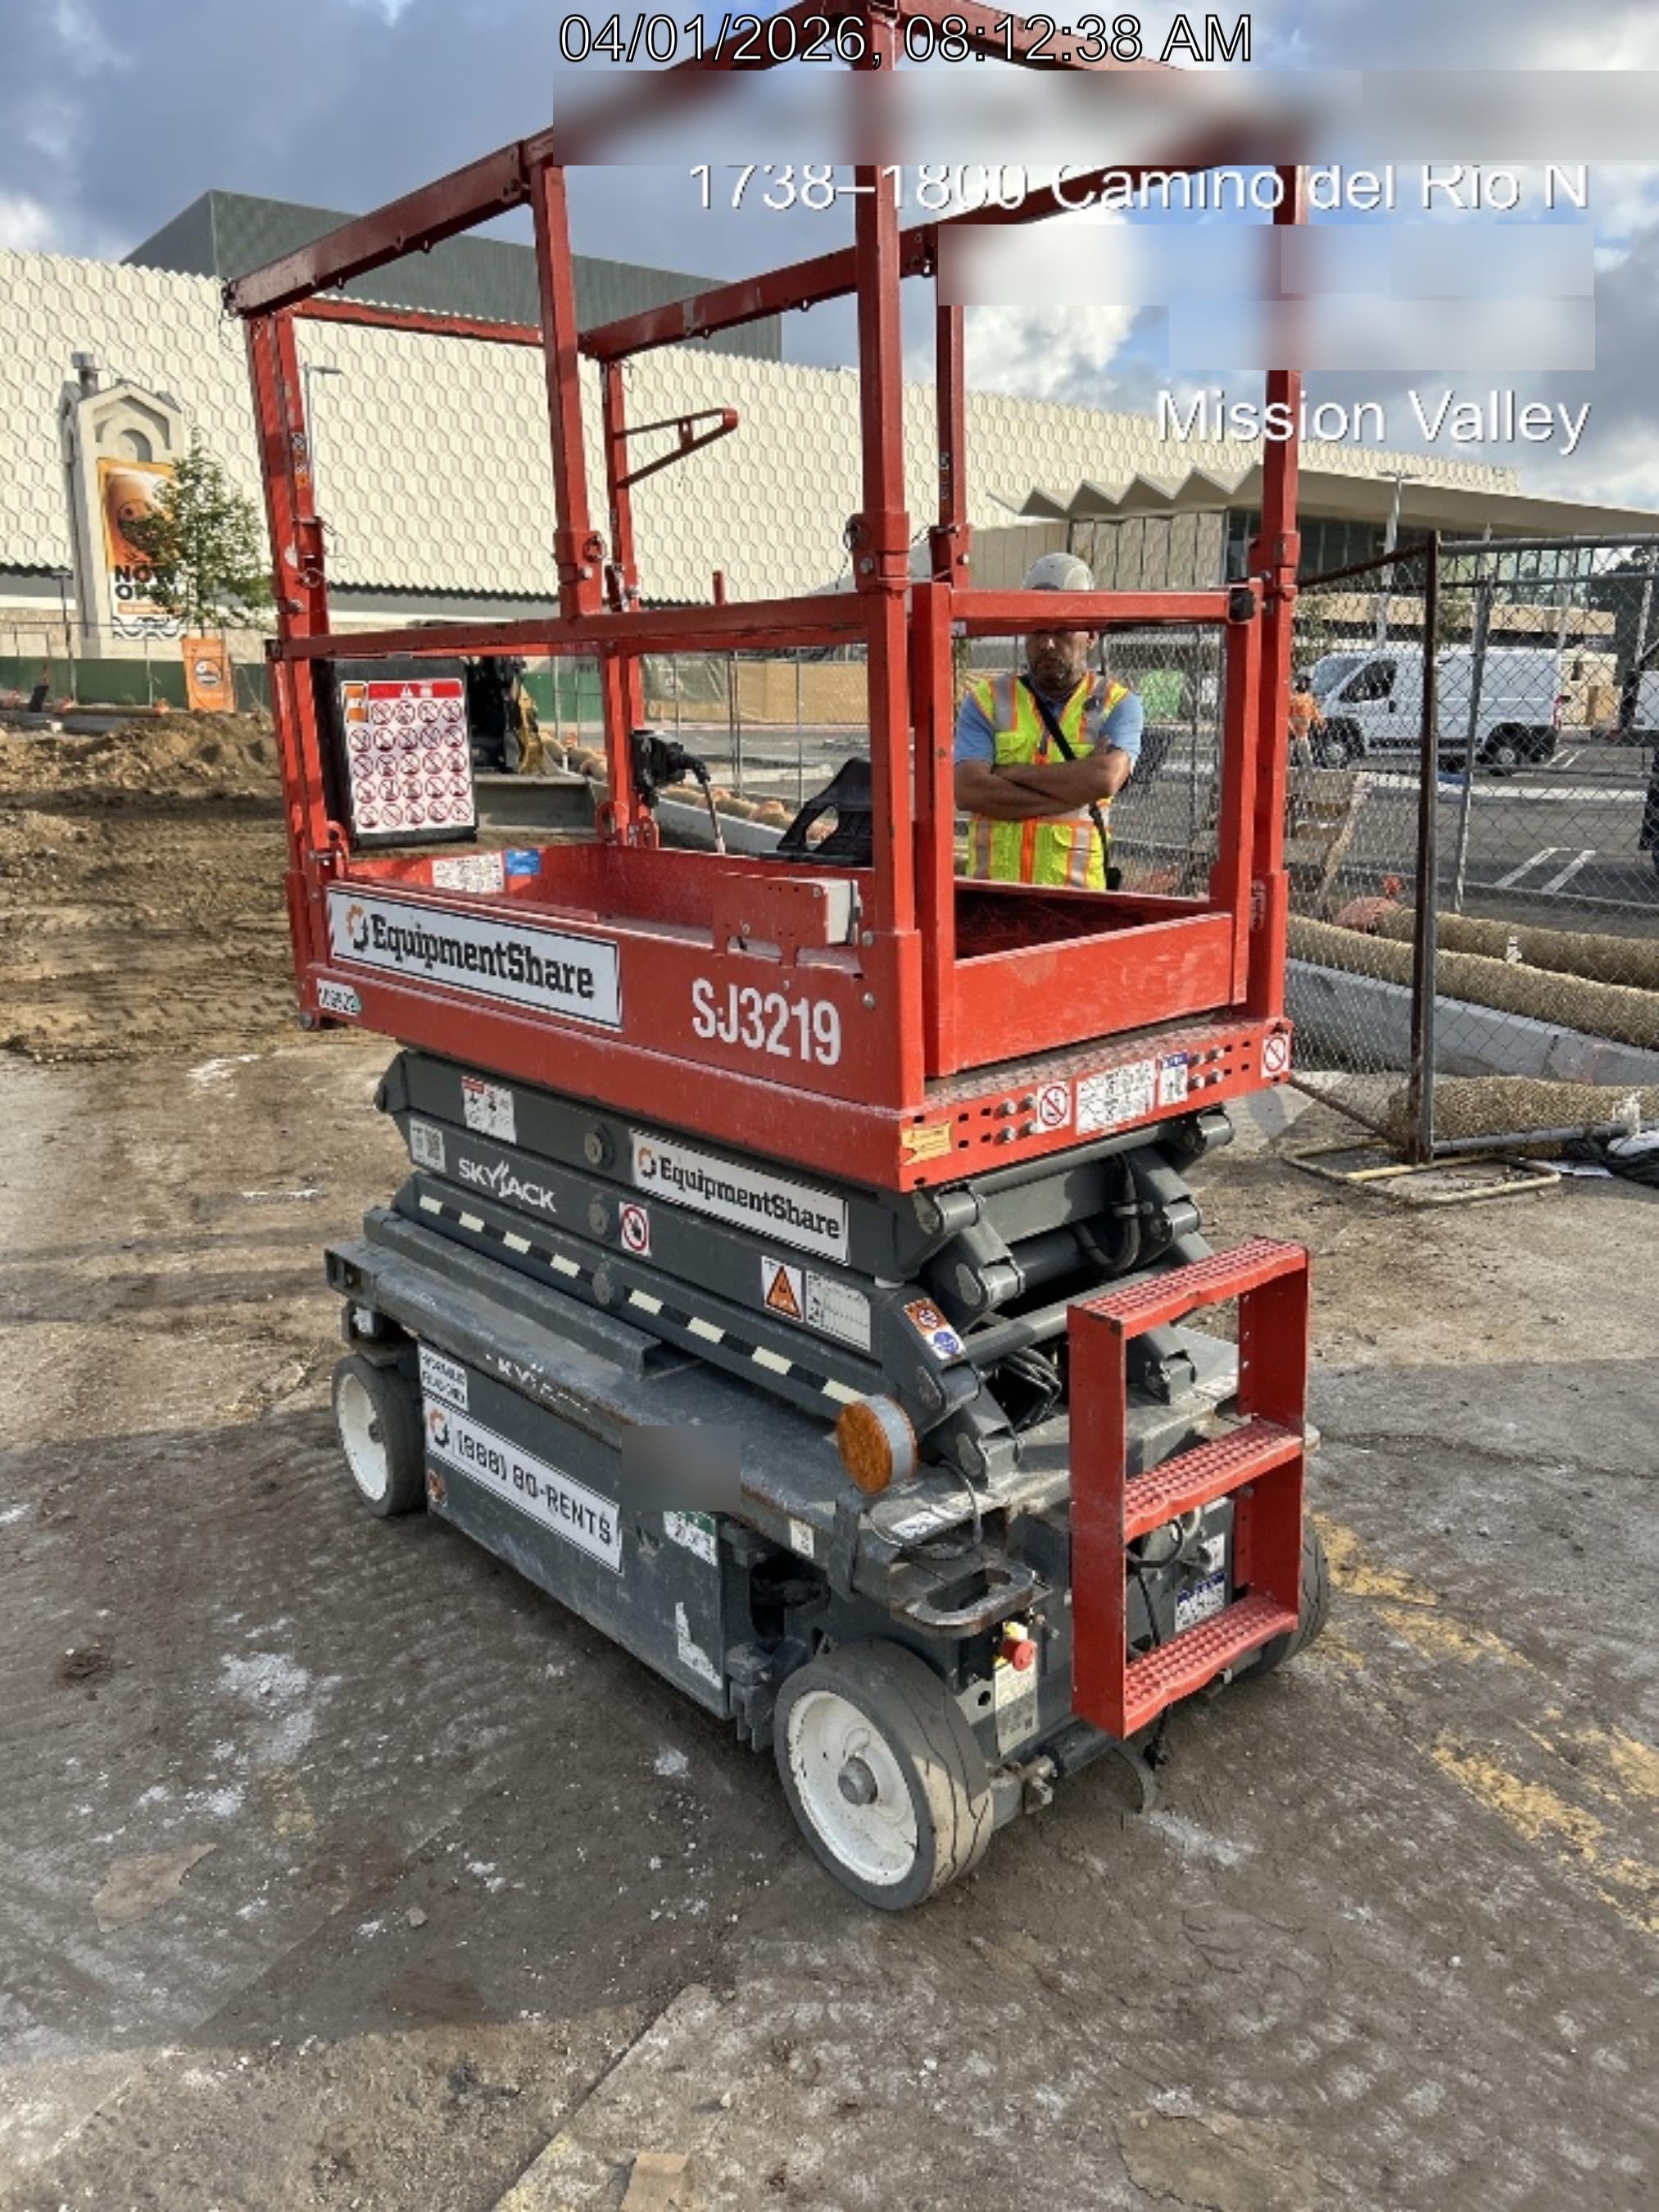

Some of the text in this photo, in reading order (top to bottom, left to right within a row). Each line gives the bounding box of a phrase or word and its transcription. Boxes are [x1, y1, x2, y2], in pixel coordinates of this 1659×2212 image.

[370, 913, 596, 999] EquipmentShare
[692, 977, 841, 1065] SJ3219
[459, 1157, 557, 1213] SKYJACK
[660, 1157, 840, 1239] EquipmentShare
[457, 1430, 507, 1480] (888)
[513, 1464, 611, 1547] 80-RENTS
